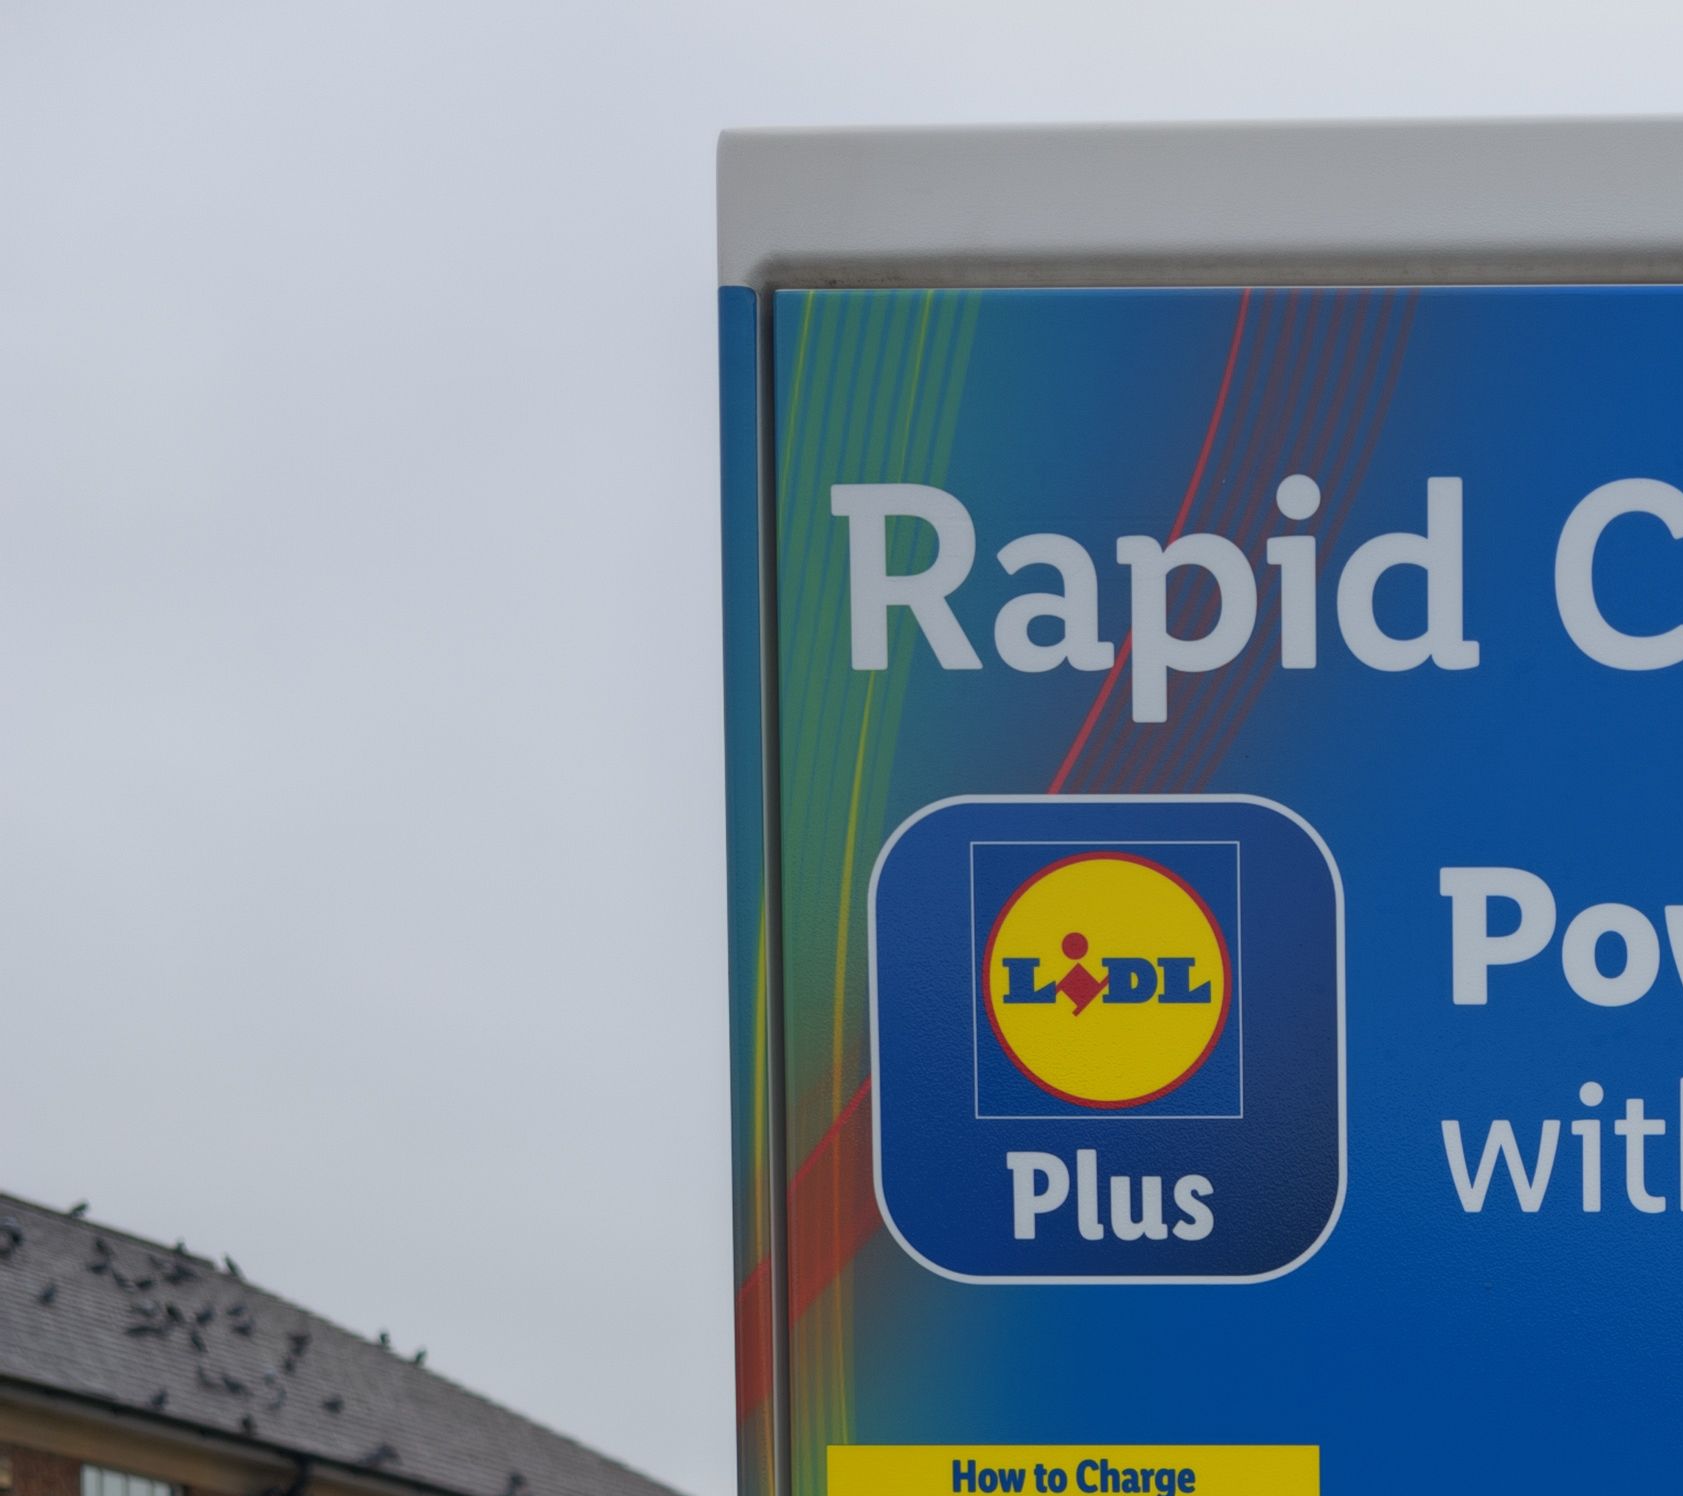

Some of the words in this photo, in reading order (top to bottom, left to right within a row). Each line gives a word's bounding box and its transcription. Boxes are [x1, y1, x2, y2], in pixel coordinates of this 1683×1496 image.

[829, 472, 1479, 725] Rapid
[1002, 930, 1215, 1016] LIDL
[1007, 1150, 1213, 1240] Plus
[953, 1460, 1025, 1493] How
[1034, 1464, 1067, 1493] to
